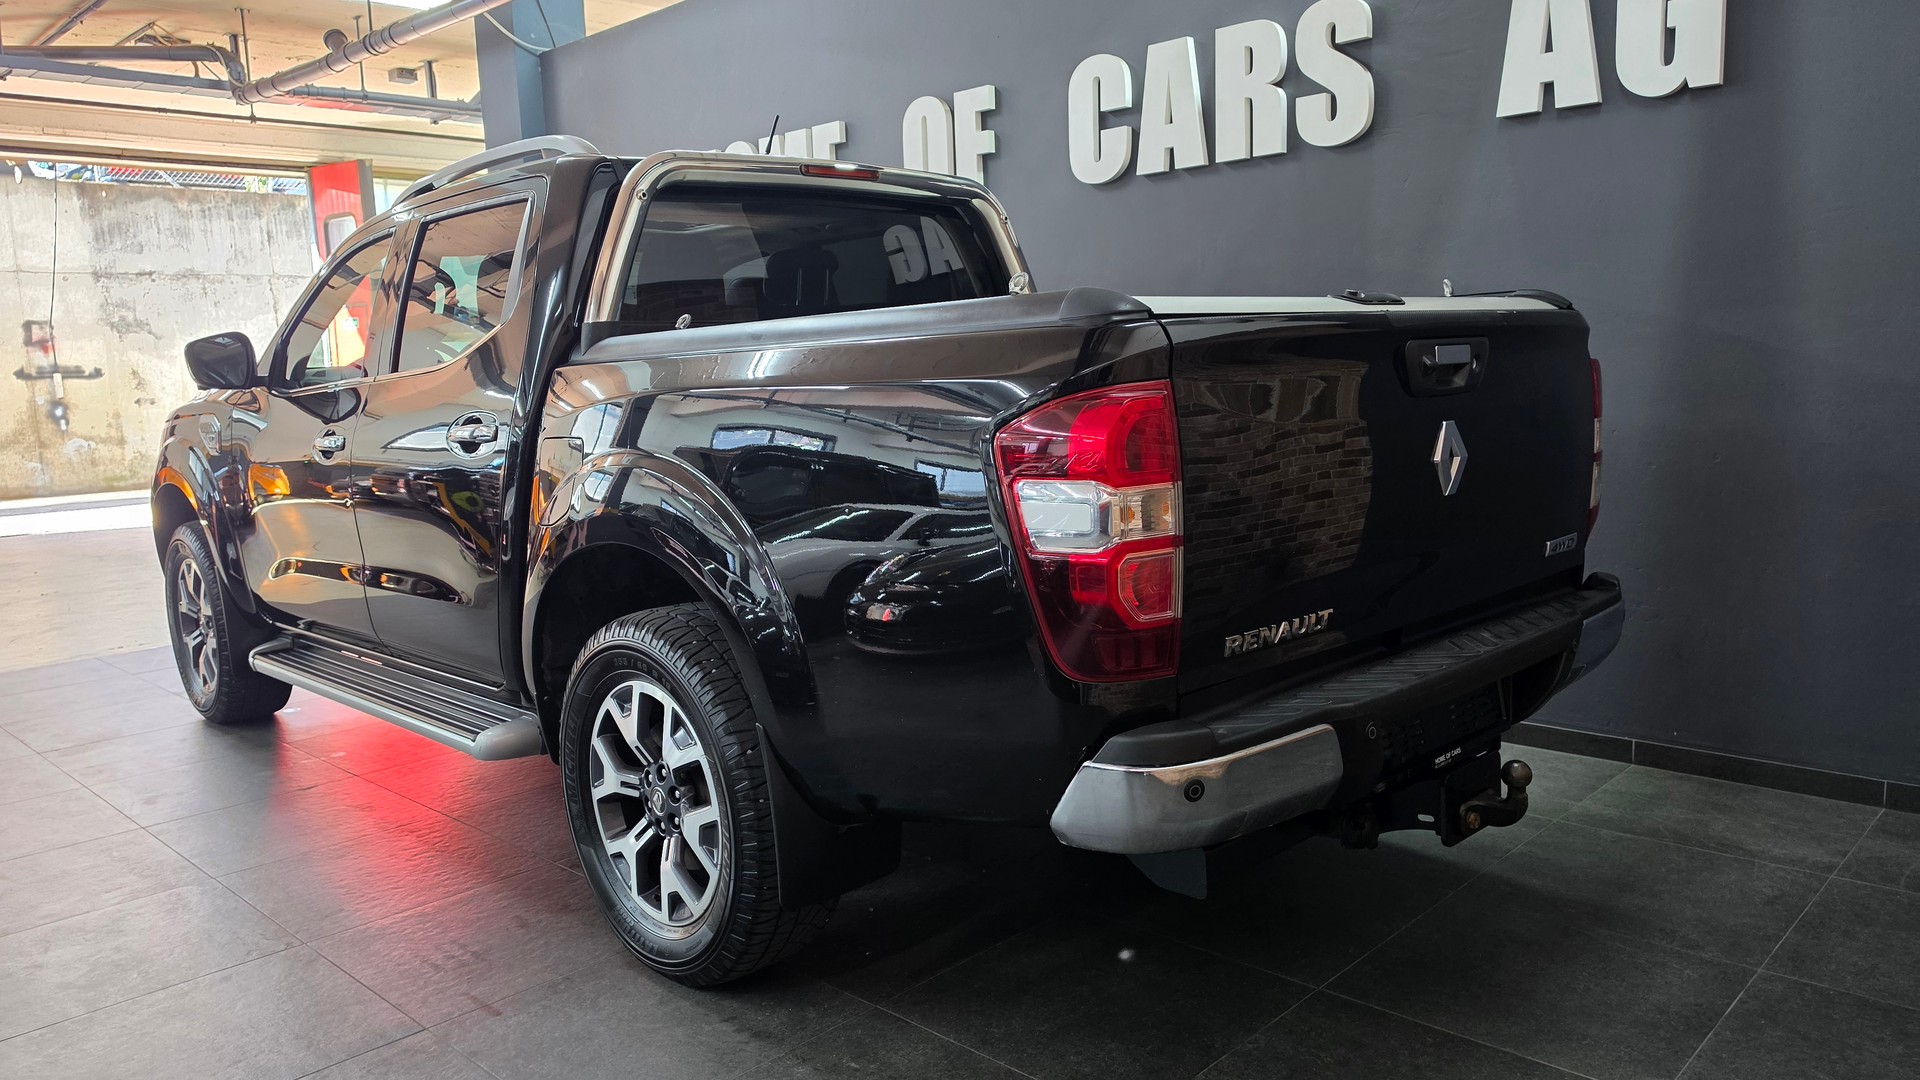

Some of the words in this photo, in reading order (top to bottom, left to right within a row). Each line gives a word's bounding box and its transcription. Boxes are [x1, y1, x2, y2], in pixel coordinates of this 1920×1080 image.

[902, 84, 996, 186] OF
[1067, 0, 1375, 184] CARS
[1224, 608, 1333, 658] RENAULT
